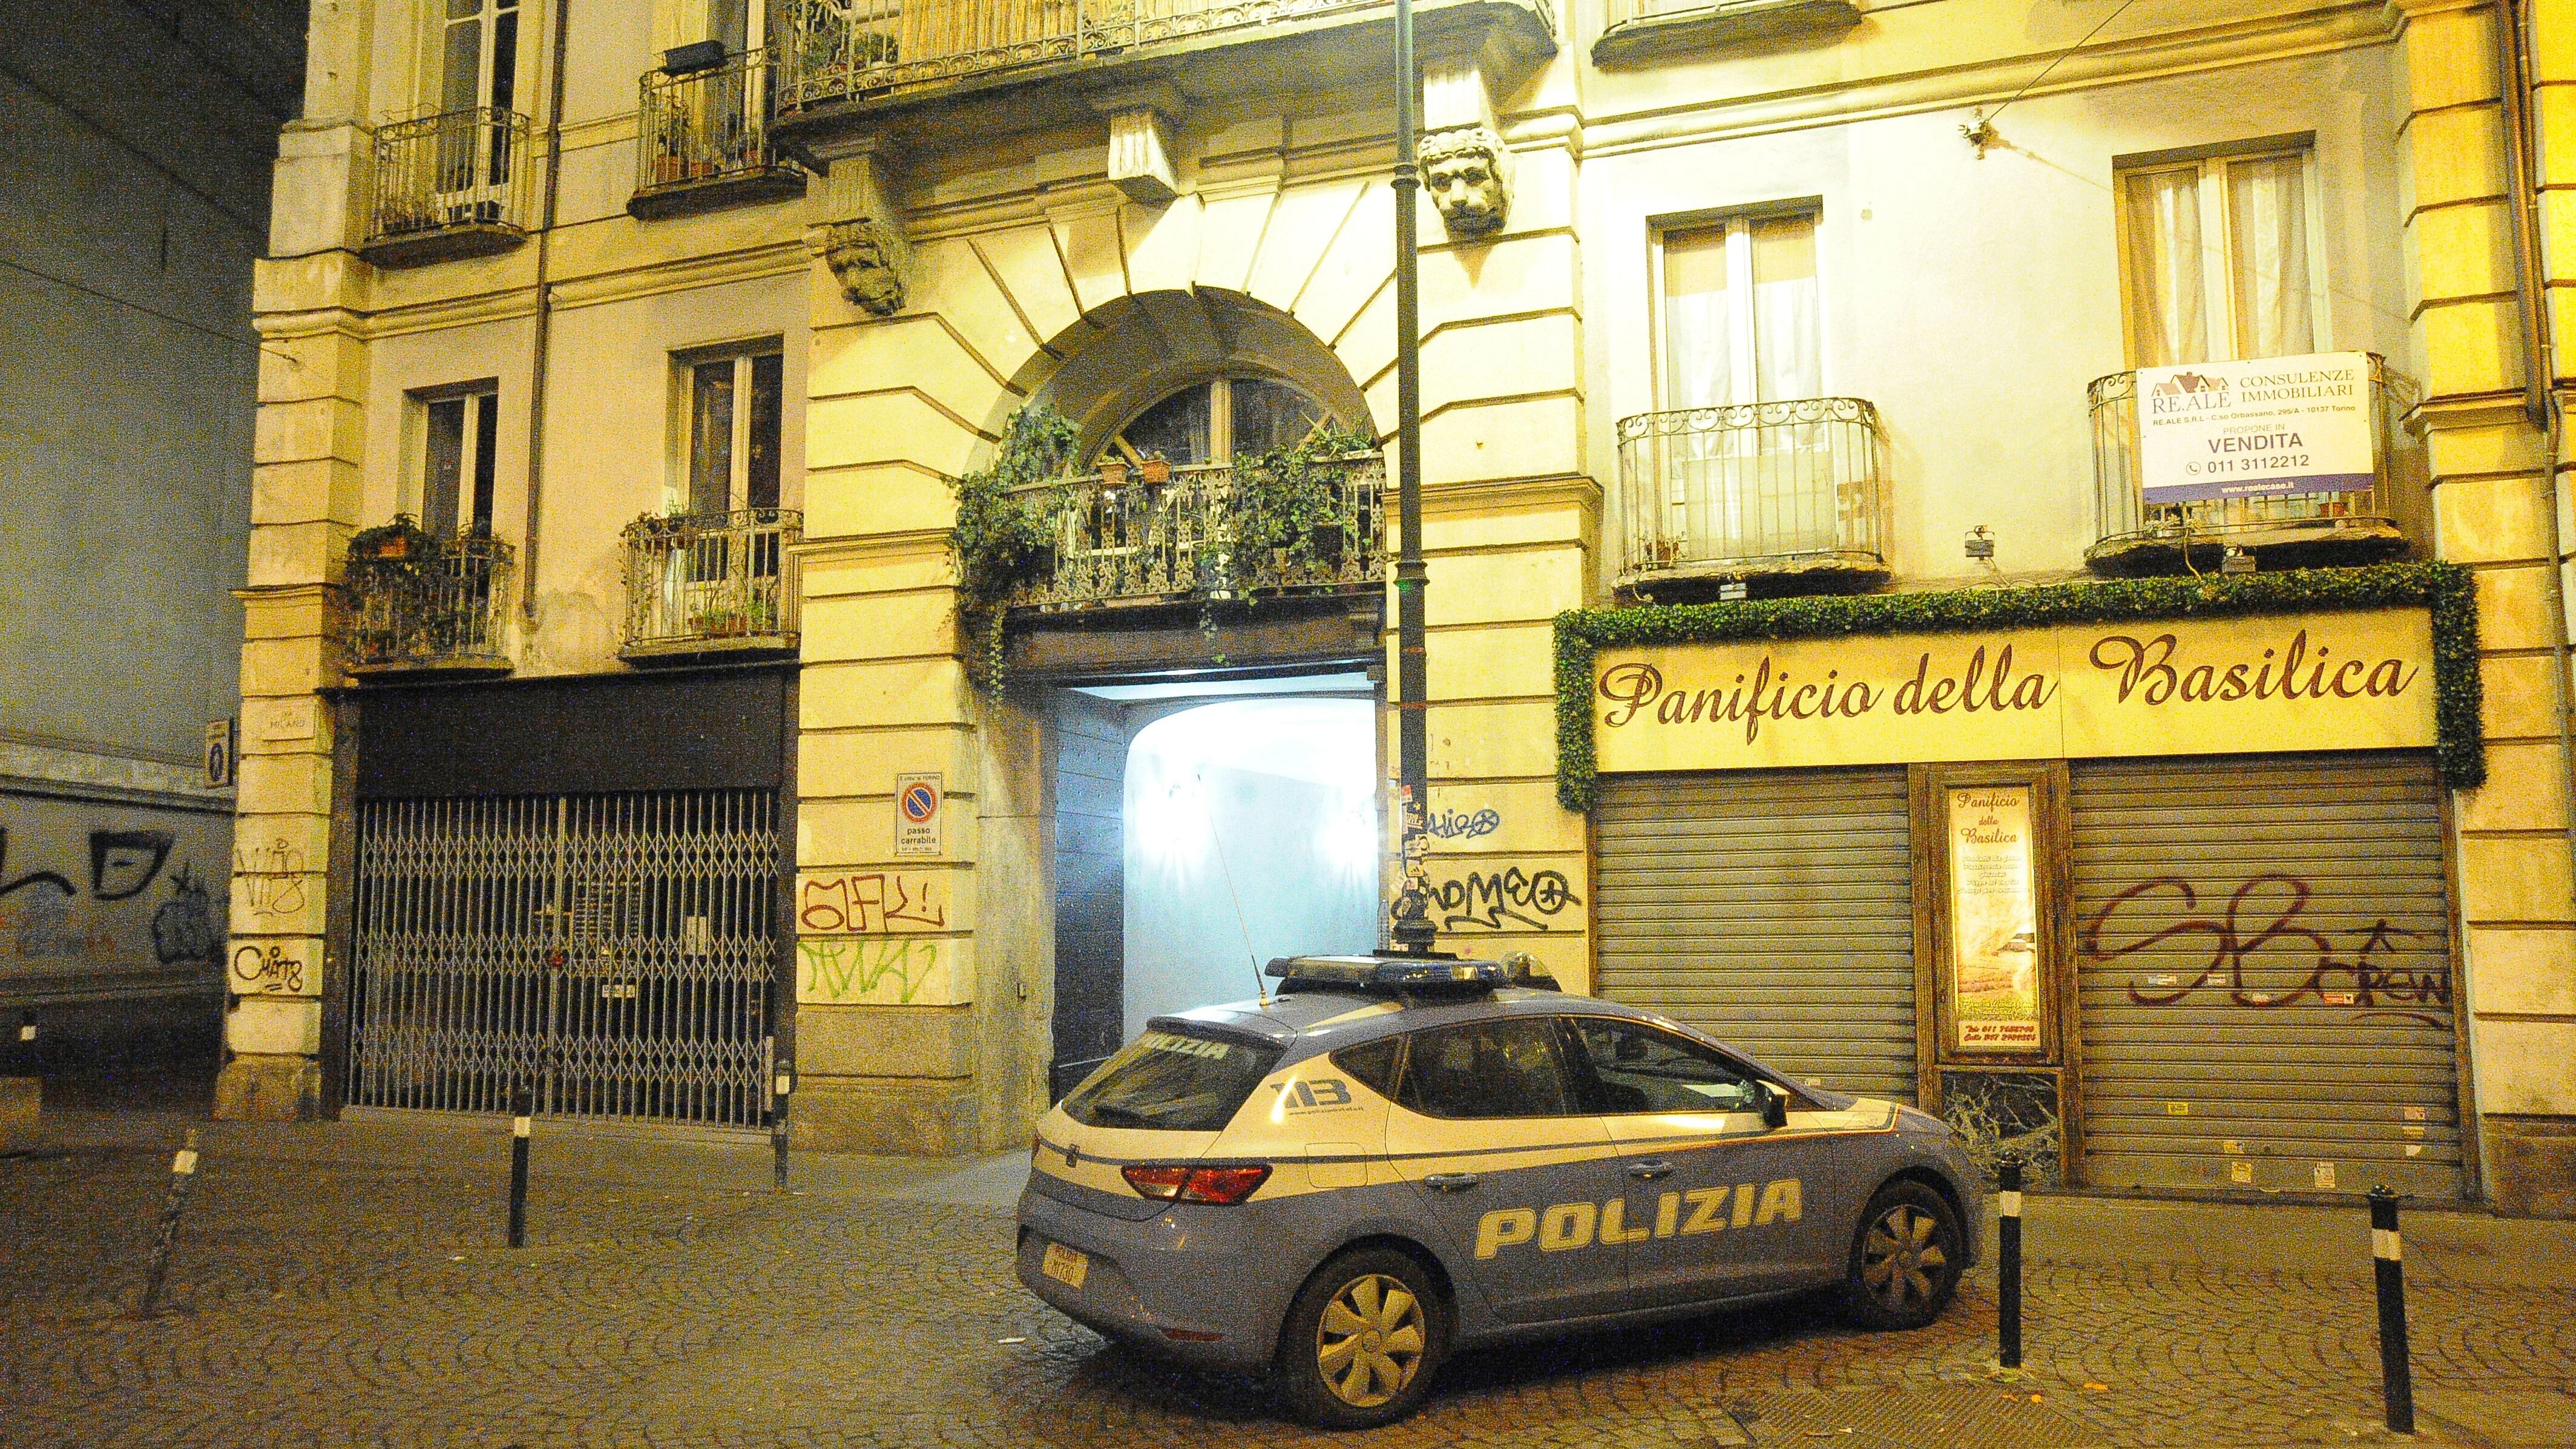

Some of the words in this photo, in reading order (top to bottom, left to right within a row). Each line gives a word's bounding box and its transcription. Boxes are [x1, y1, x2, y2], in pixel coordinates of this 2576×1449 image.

[2240, 369, 2354, 388] CONSULENZE
[2242, 384, 2353, 402] IMMOBILIARI
[2223, 424, 2271, 435] PROPONE
[2208, 433, 2303, 453] VENDITA
[2208, 460, 2233, 473] 011
[2241, 455, 2309, 470] 3112212
[1598, 656, 1884, 746] Panificio
[1893, 644, 2058, 715] della
[2089, 628, 2420, 707] Basilica
[1957, 792, 2019, 812] Panificio
[901, 835, 936, 844] carrabile
[1961, 828, 2019, 844] Basilica
[1269, 1079, 1352, 1109] 113
[1474, 1177, 1803, 1260] POLIZIA
